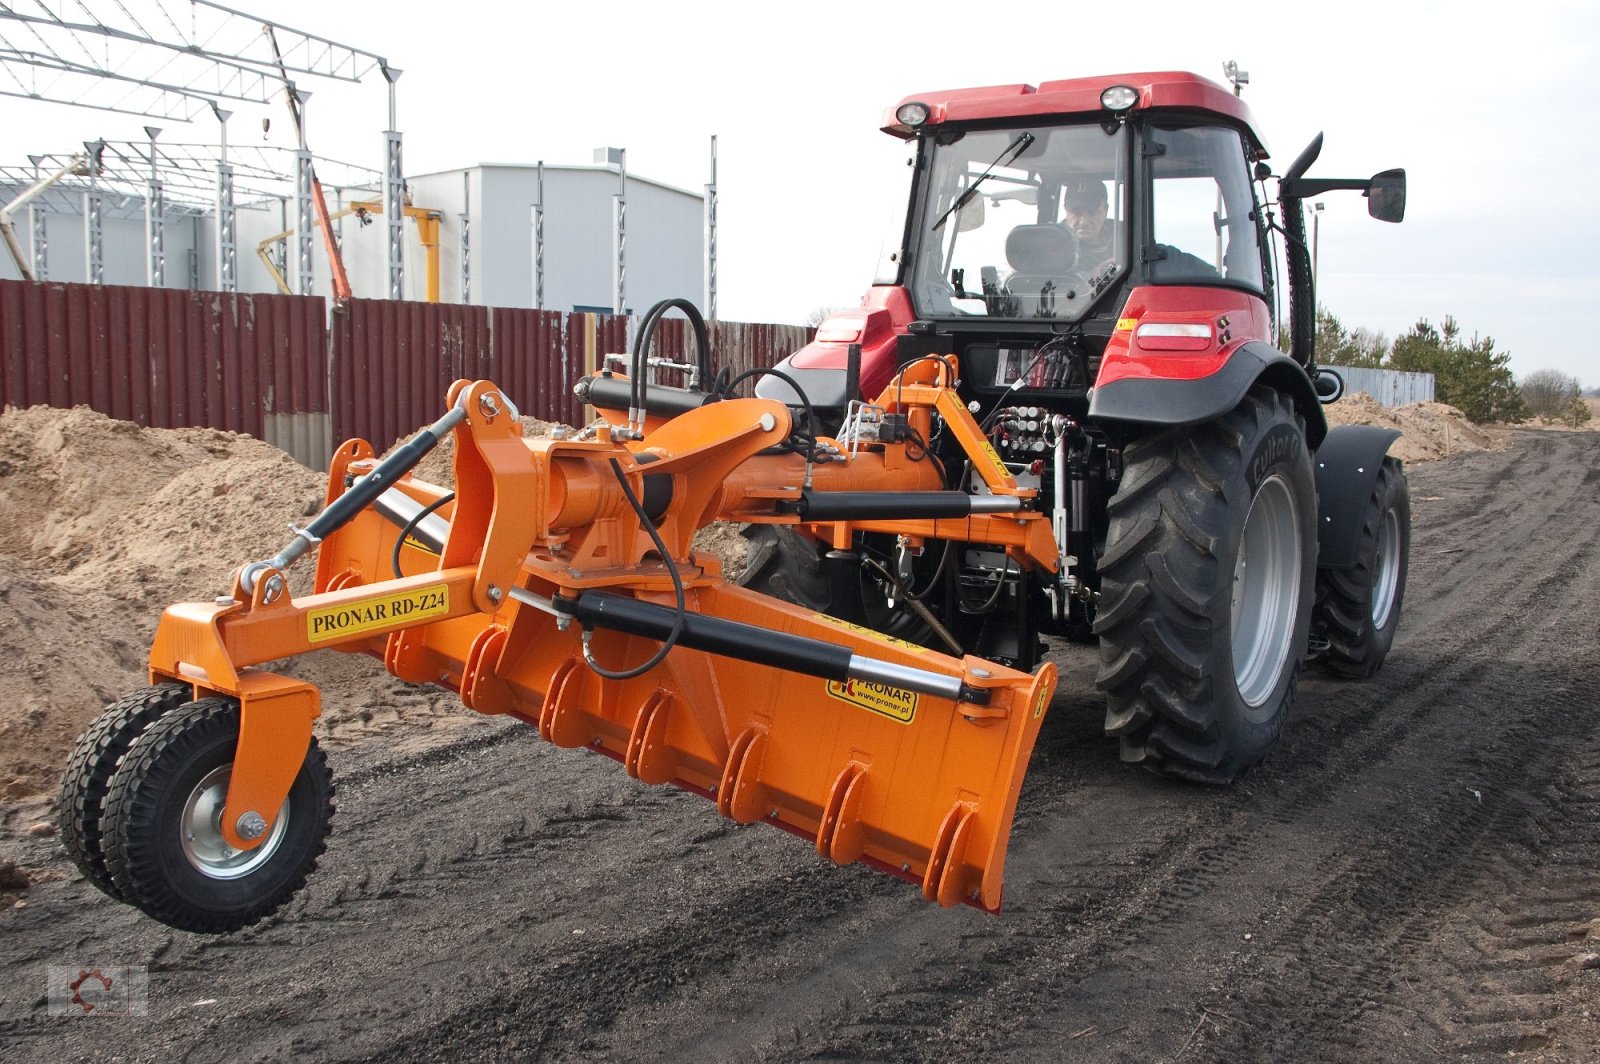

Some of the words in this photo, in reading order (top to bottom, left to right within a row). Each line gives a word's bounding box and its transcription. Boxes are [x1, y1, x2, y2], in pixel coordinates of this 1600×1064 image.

[313, 604, 386, 633] PRONAR
[391, 592, 445, 617] RD-Z24
[857, 691, 909, 714] www.pronar.pl
